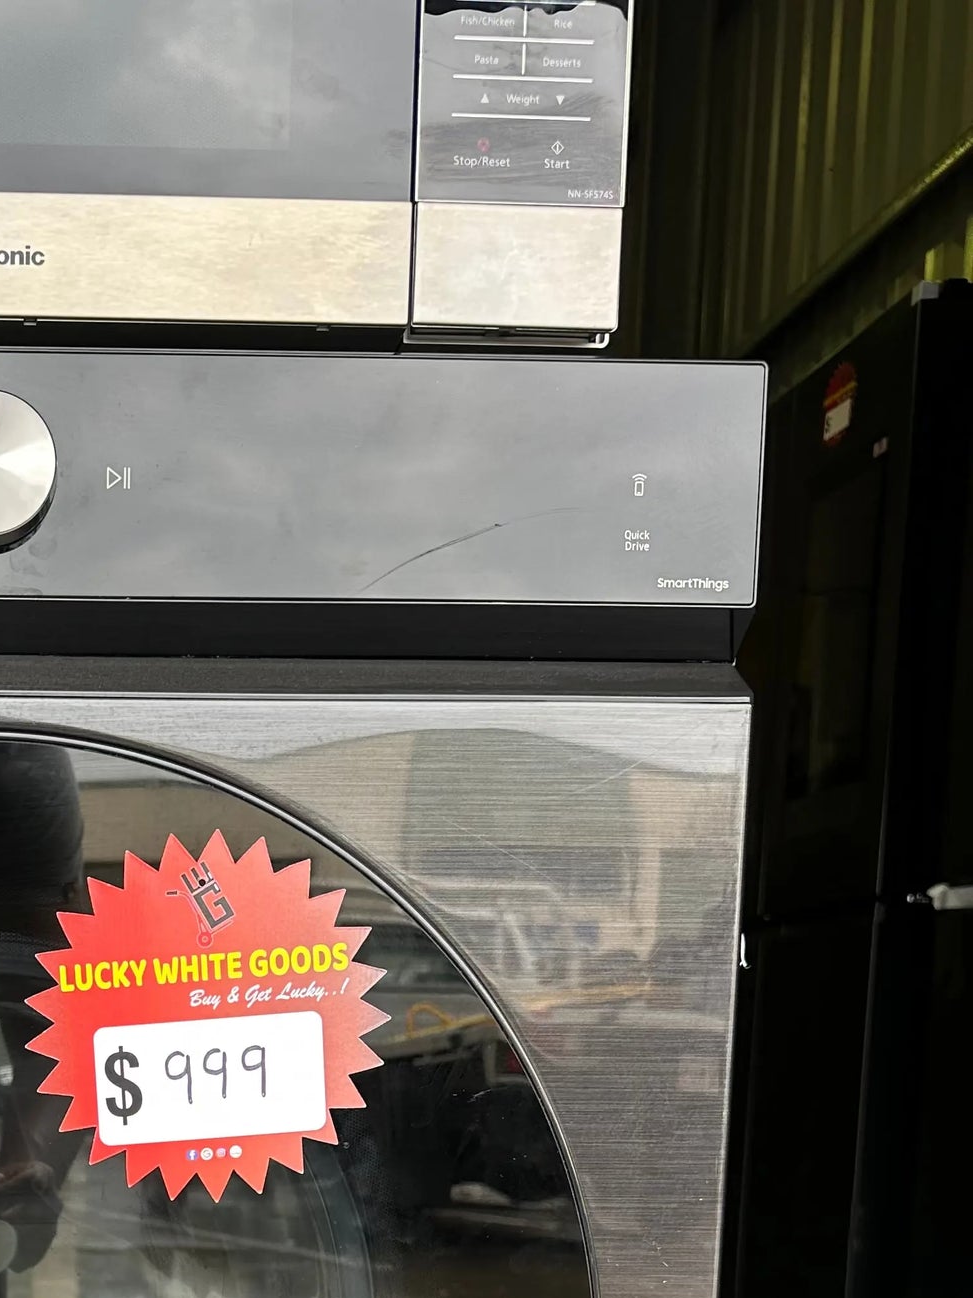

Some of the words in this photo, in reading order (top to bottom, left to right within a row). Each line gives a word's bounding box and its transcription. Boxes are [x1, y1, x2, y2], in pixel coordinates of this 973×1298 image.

[461, 16, 515, 28] Fish/Chicken
[554, 19, 573, 29] Rice
[474, 55, 499, 65] Pasta
[543, 57, 581, 68] Desserts
[506, 94, 540, 106] Weight
[453, 156, 511, 169] Stop/Reset
[544, 159, 570, 169] Start
[624, 530, 650, 541] Quick
[625, 541, 650, 551] Drive
[657, 577, 730, 592] SmartThings
[58, 959, 147, 993] LUCKY
[152, 951, 243, 986] WHITE
[249, 942, 350, 978] GOODS
[189, 989, 222, 1010] Buy
[227, 986, 240, 1004] &
[244, 986, 272, 1008] Get
[104, 1045, 143, 1126] $
[164, 1044, 267, 1105] 999
